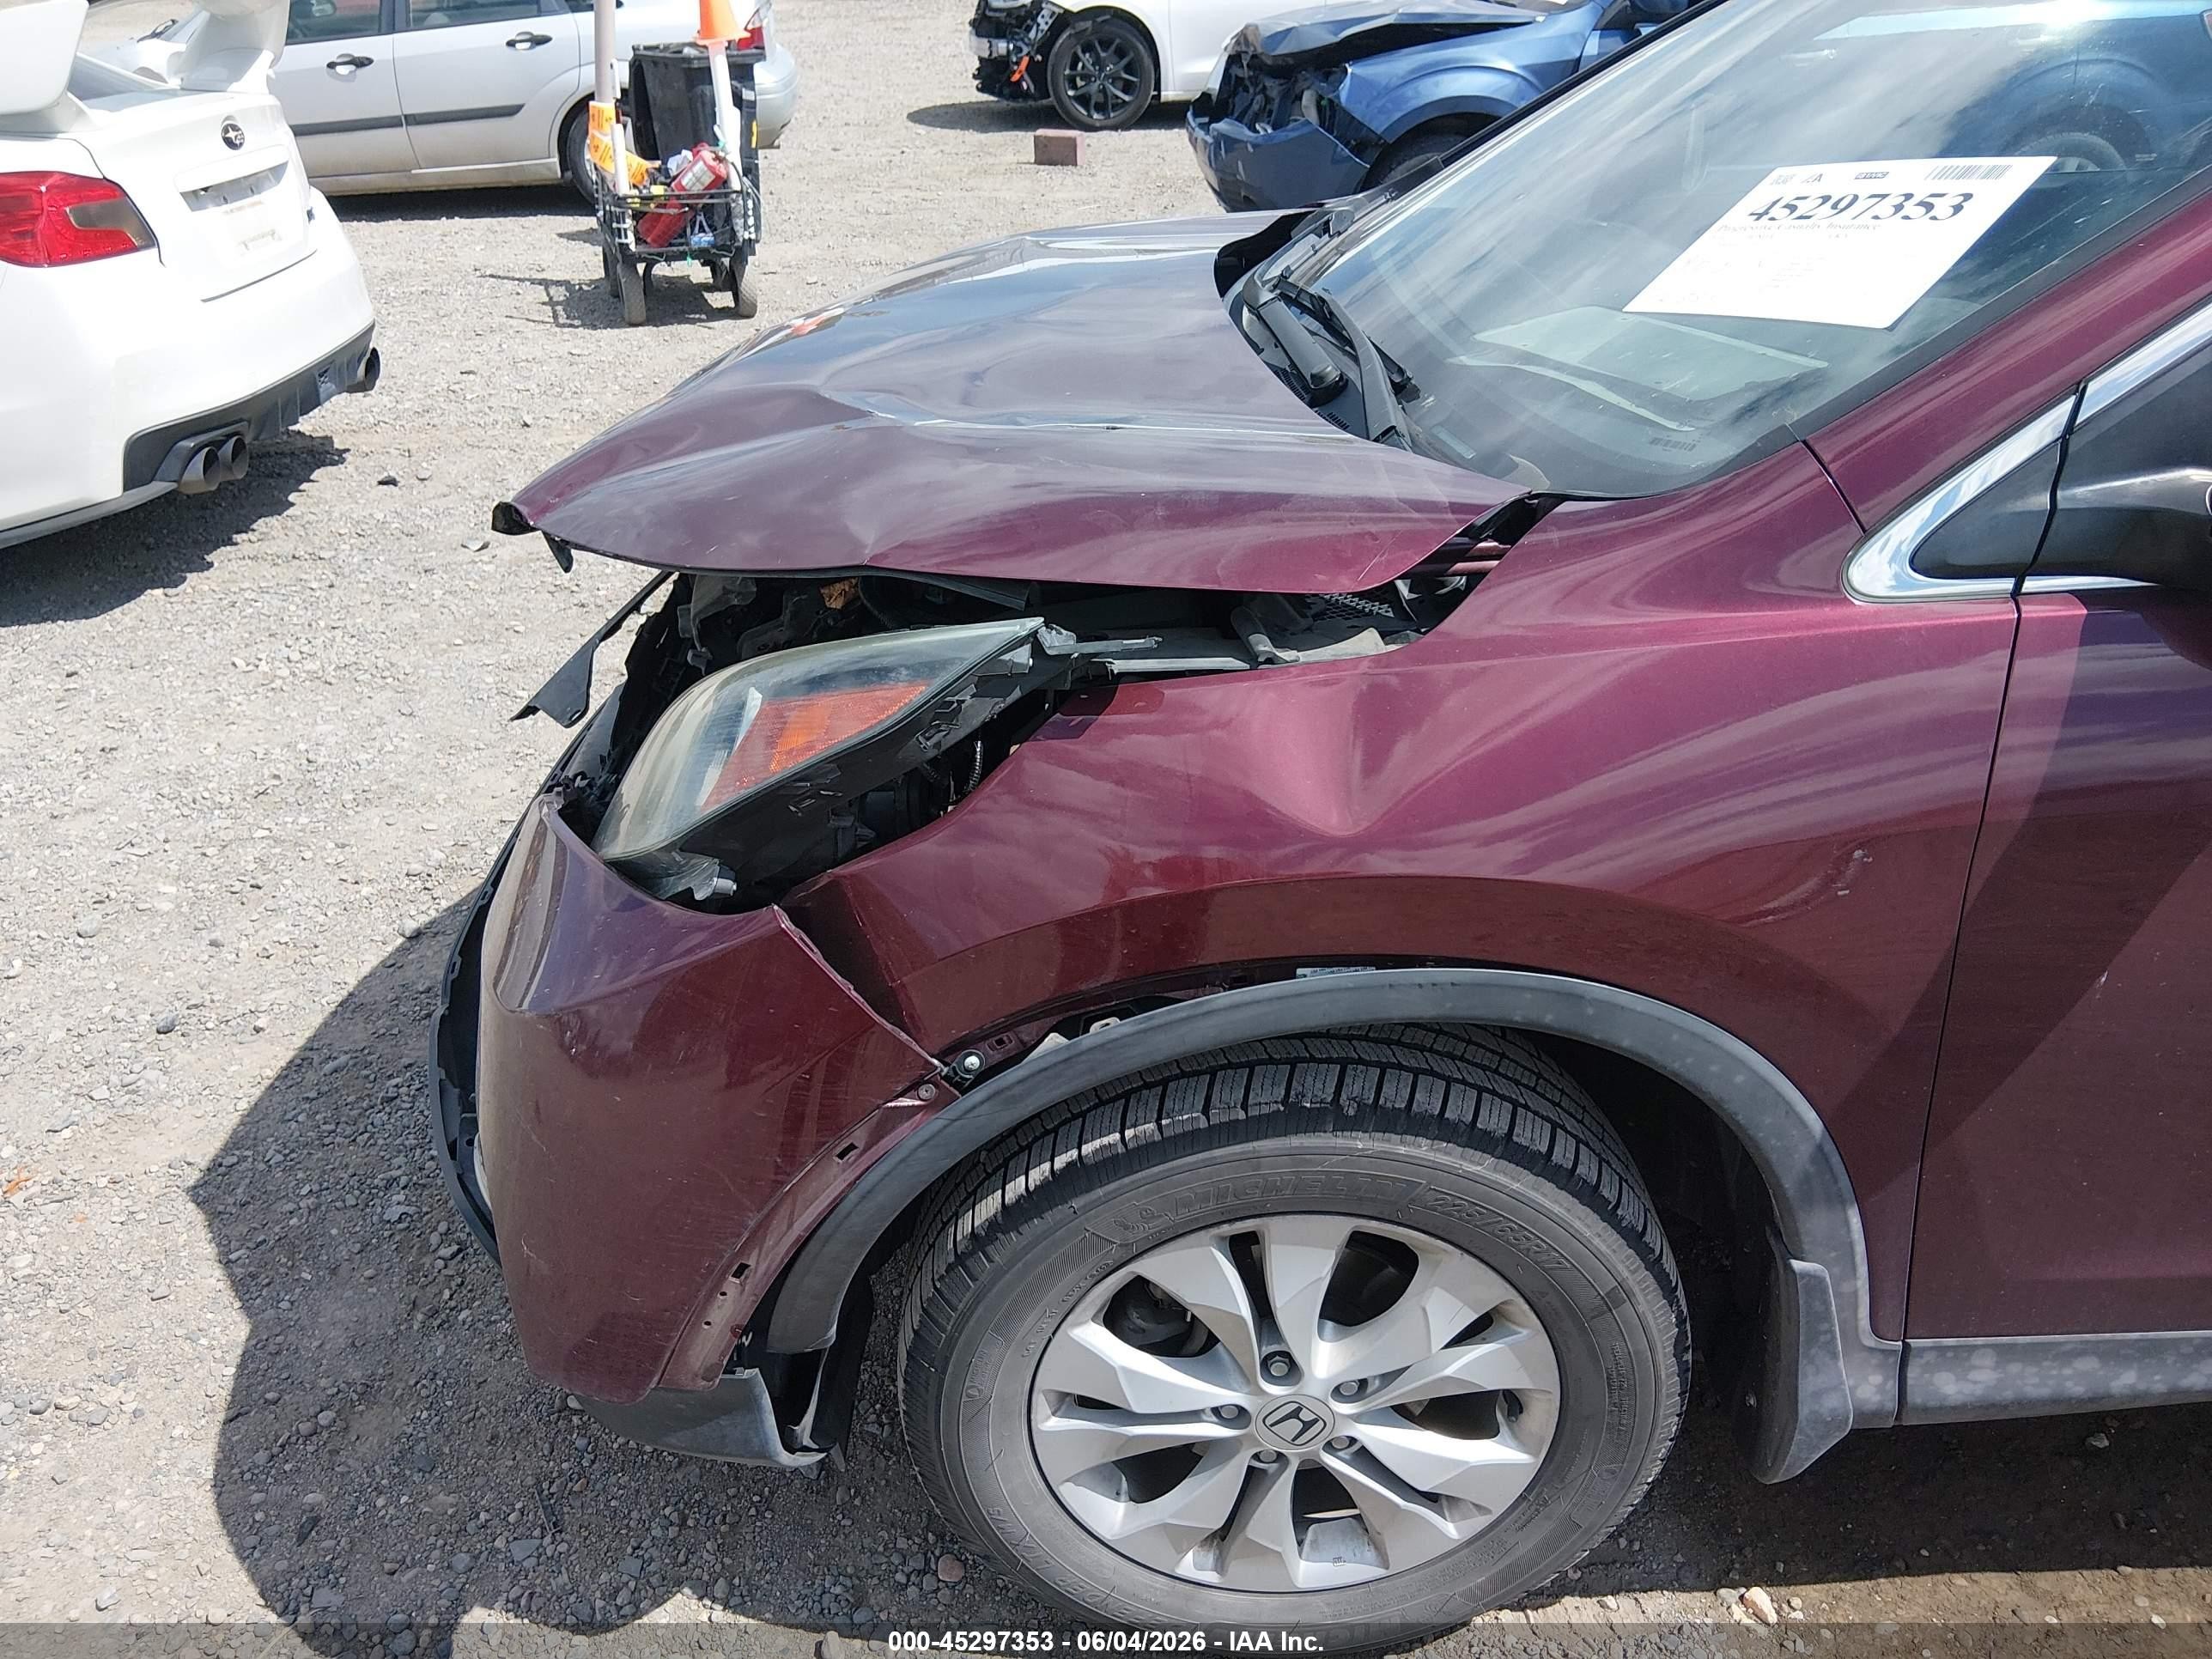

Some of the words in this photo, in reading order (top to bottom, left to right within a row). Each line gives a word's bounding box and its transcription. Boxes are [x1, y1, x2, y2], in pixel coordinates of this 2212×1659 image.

[1747, 193, 1973, 221] 45297353
[1175, 1175, 1413, 1216] MICHELIN
[1429, 1194, 1571, 1269] 225/65R17
